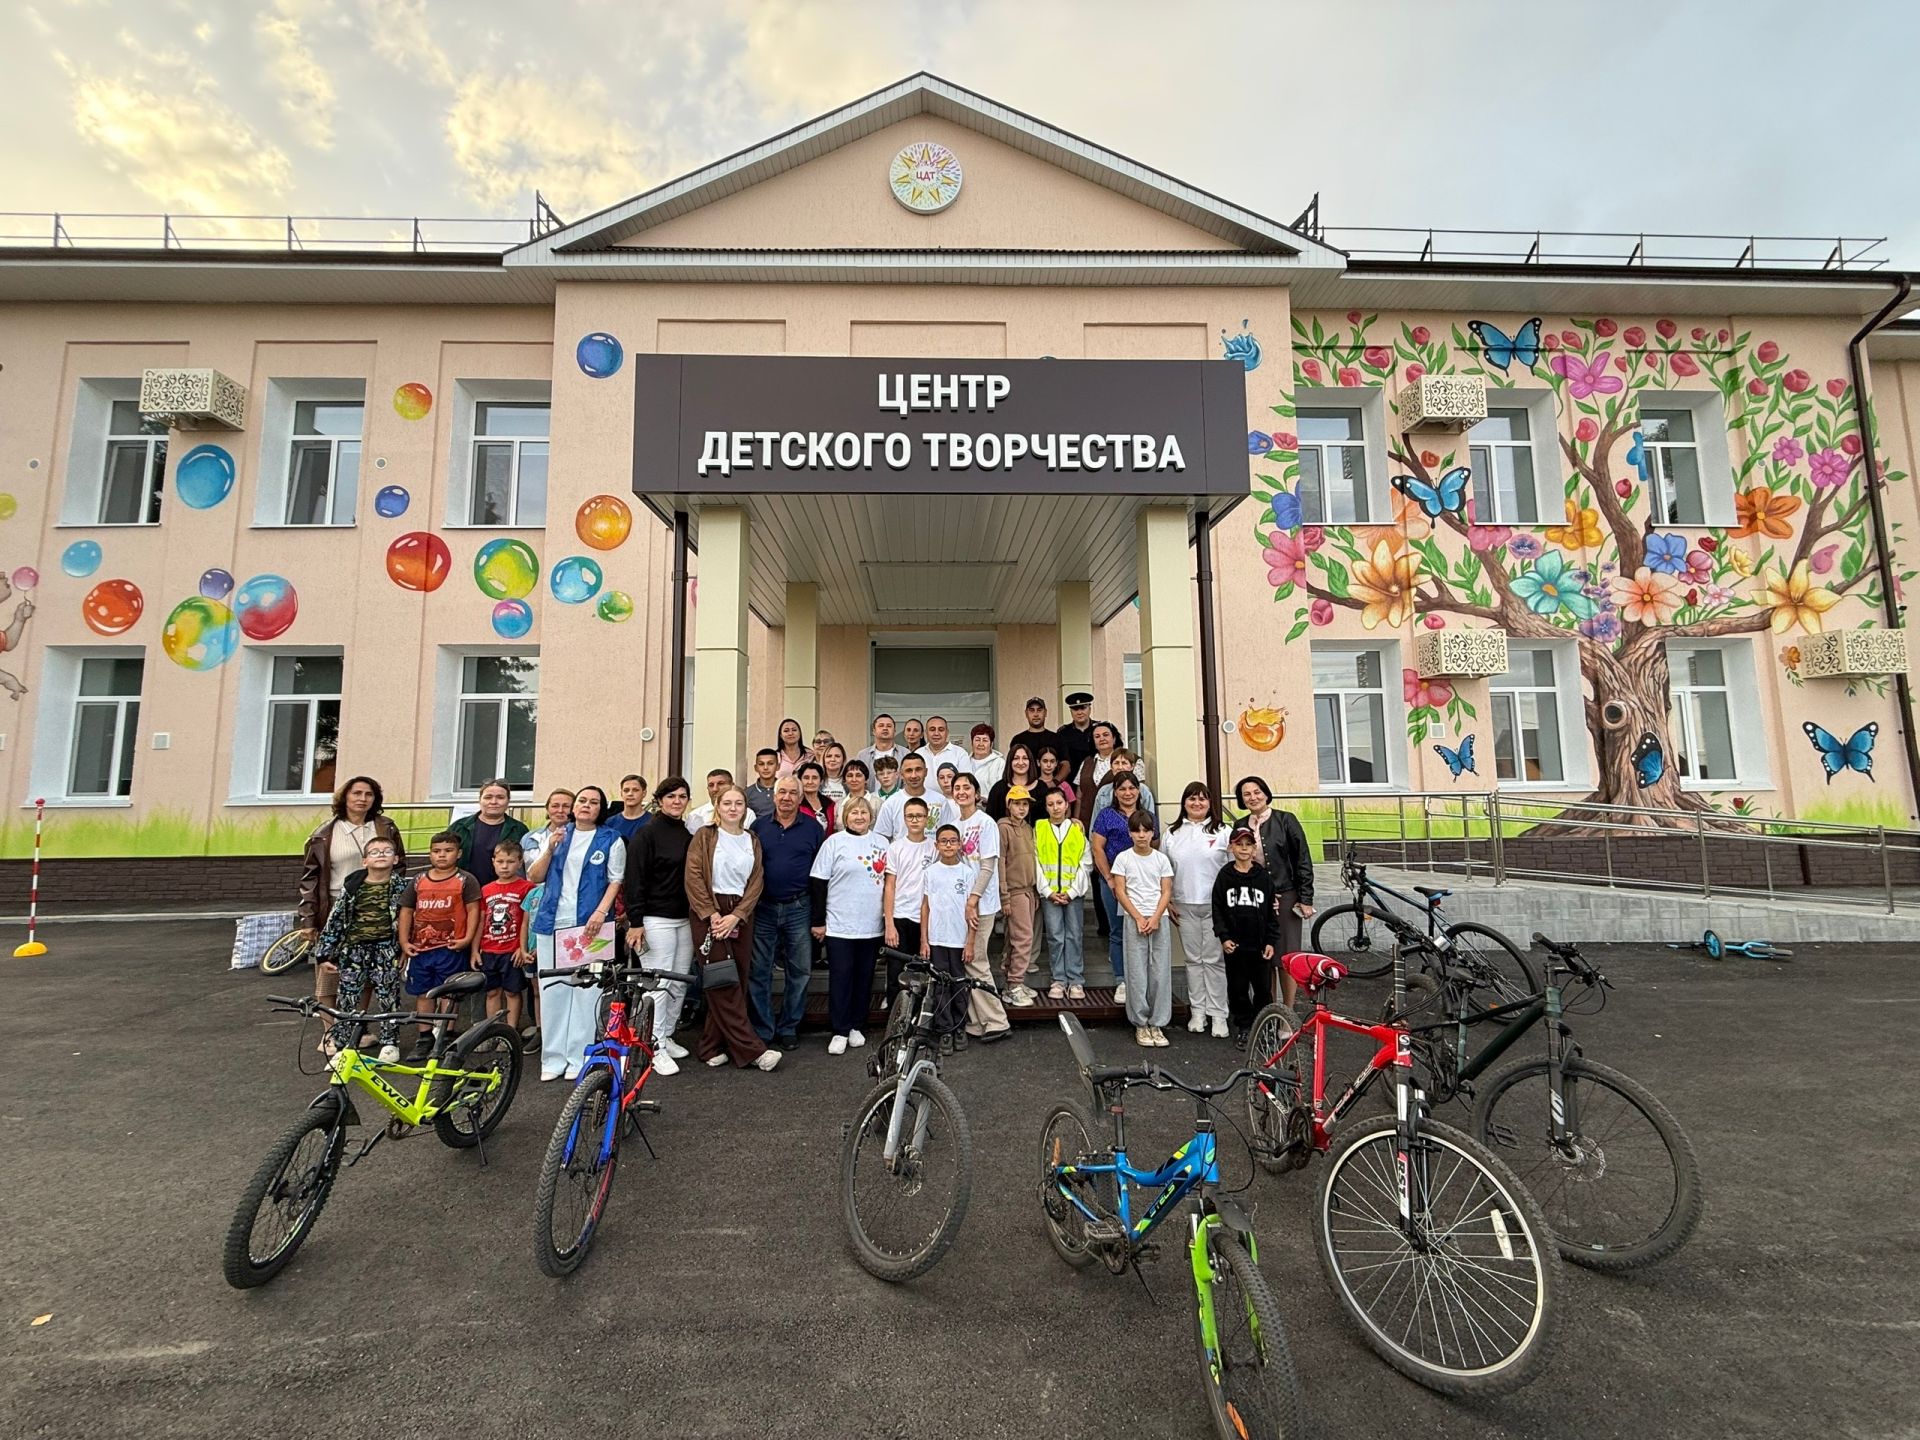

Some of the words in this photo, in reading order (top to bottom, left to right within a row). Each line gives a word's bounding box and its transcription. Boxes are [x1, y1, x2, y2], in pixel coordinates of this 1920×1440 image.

[878, 373, 1011, 418] ЦЕНТР
[698, 431, 911, 474] ДЕТСКОГО
[922, 432, 1186, 470] ТВОРЧЕСТВА
[1226, 886, 1265, 908] GAP
